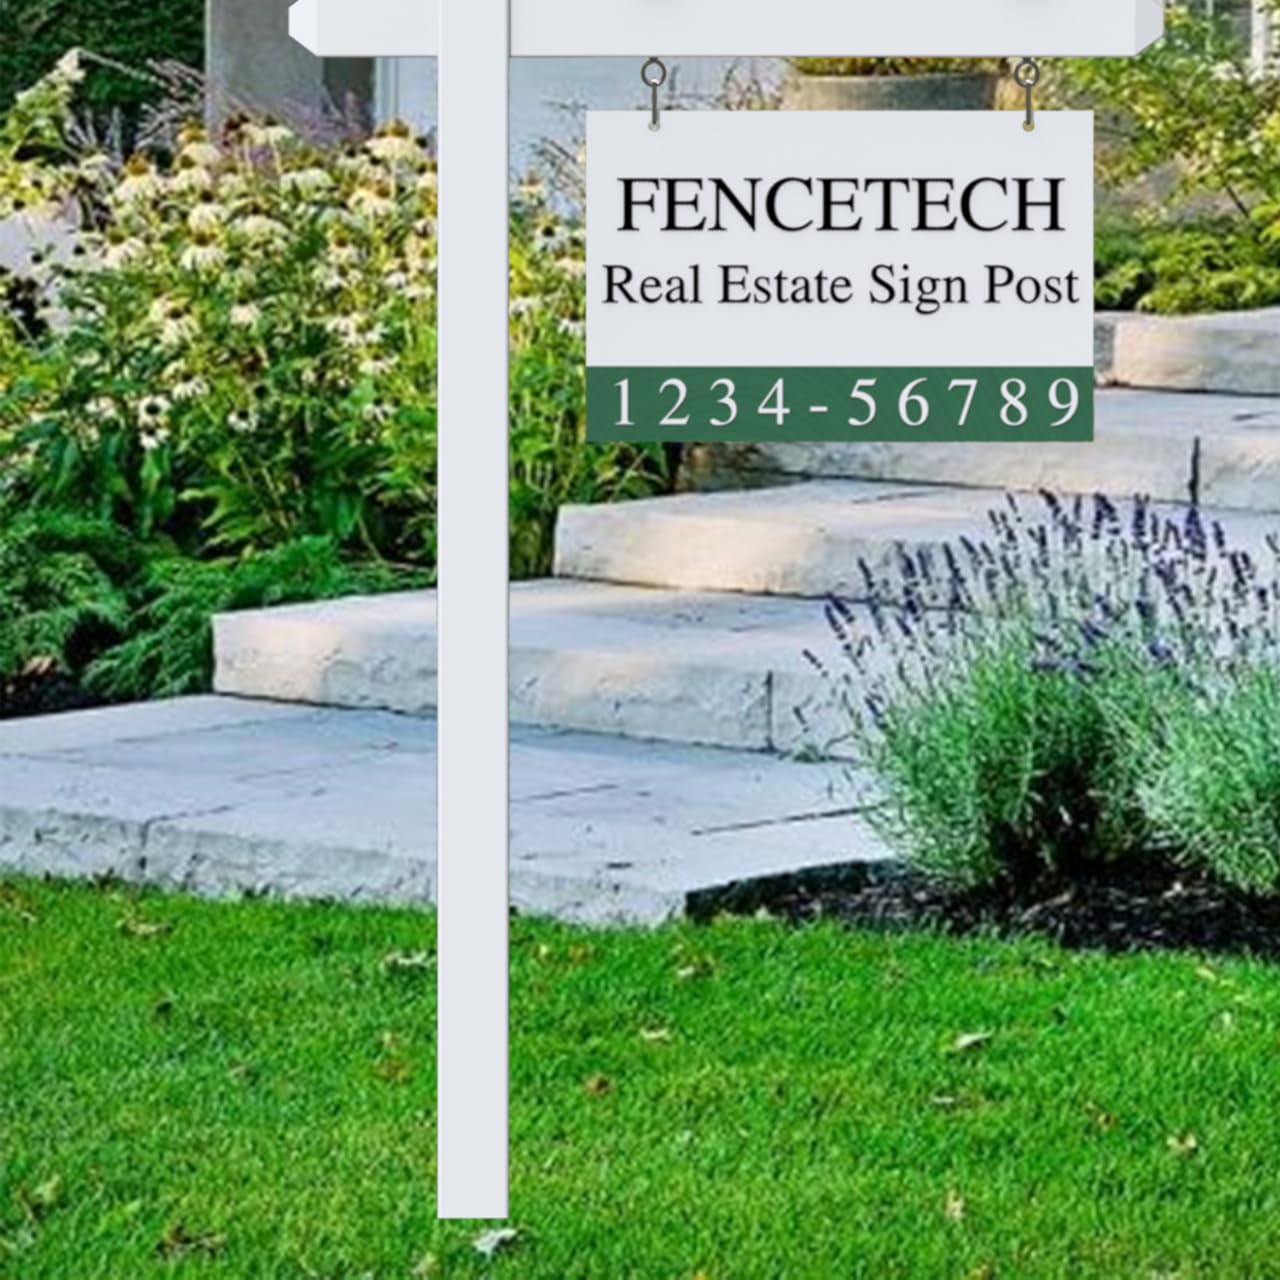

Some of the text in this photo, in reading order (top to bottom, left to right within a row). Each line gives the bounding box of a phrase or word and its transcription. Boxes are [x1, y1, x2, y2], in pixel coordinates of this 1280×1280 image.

[616, 176, 1066, 232] FENCETECH
[602, 263, 1080, 315] Real Estate Sign Post
[613, 377, 1080, 426] 1234-56789
